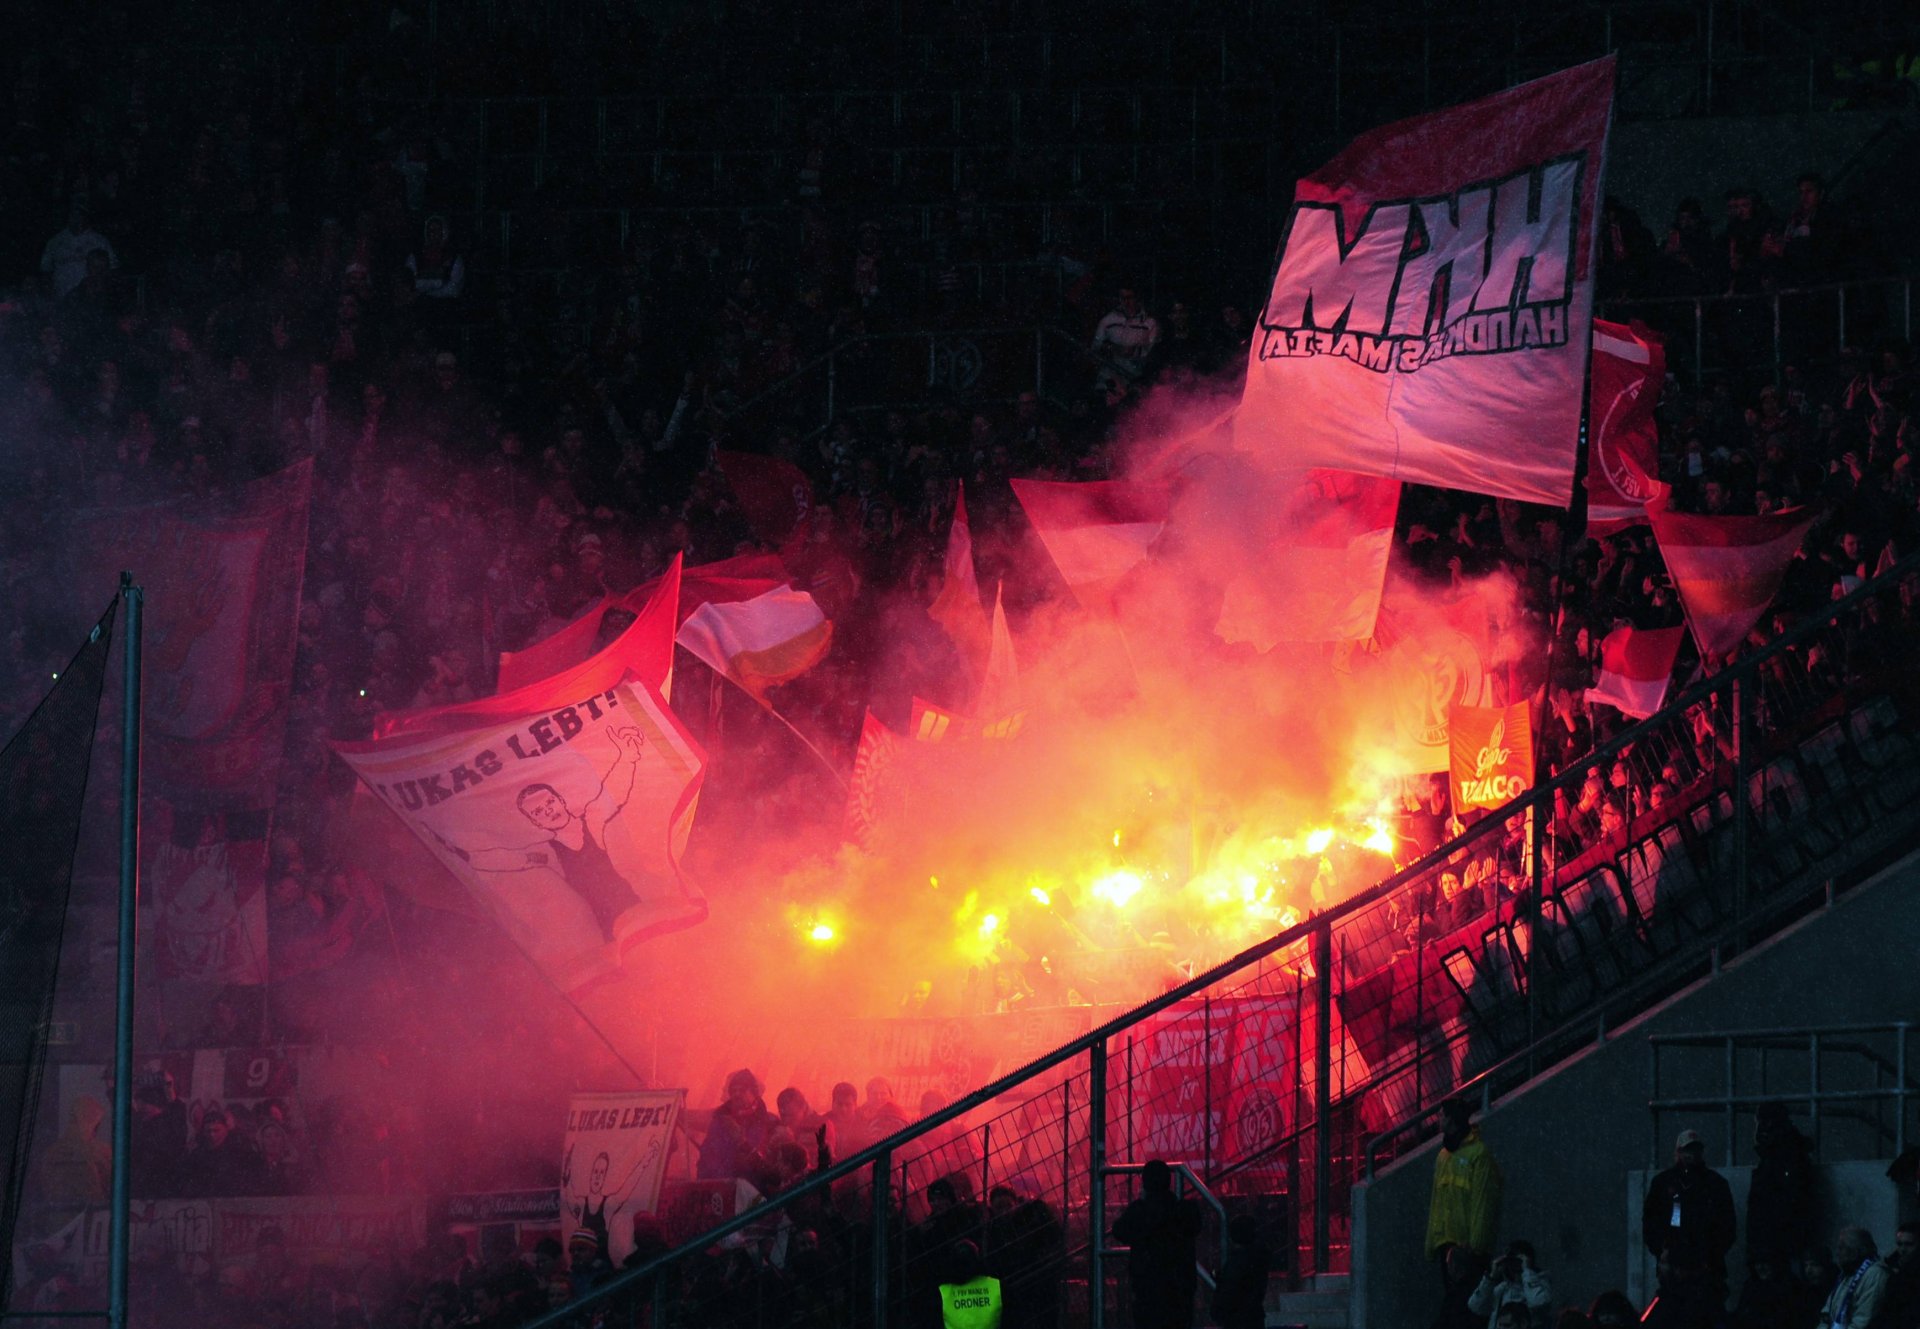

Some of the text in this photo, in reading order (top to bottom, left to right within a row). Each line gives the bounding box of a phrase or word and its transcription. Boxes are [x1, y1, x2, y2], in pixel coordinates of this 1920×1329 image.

[505, 689, 619, 760] LEBT!
[567, 1103, 672, 1132] LUKAS LEBT!
[953, 1296, 991, 1310] ORDNER
